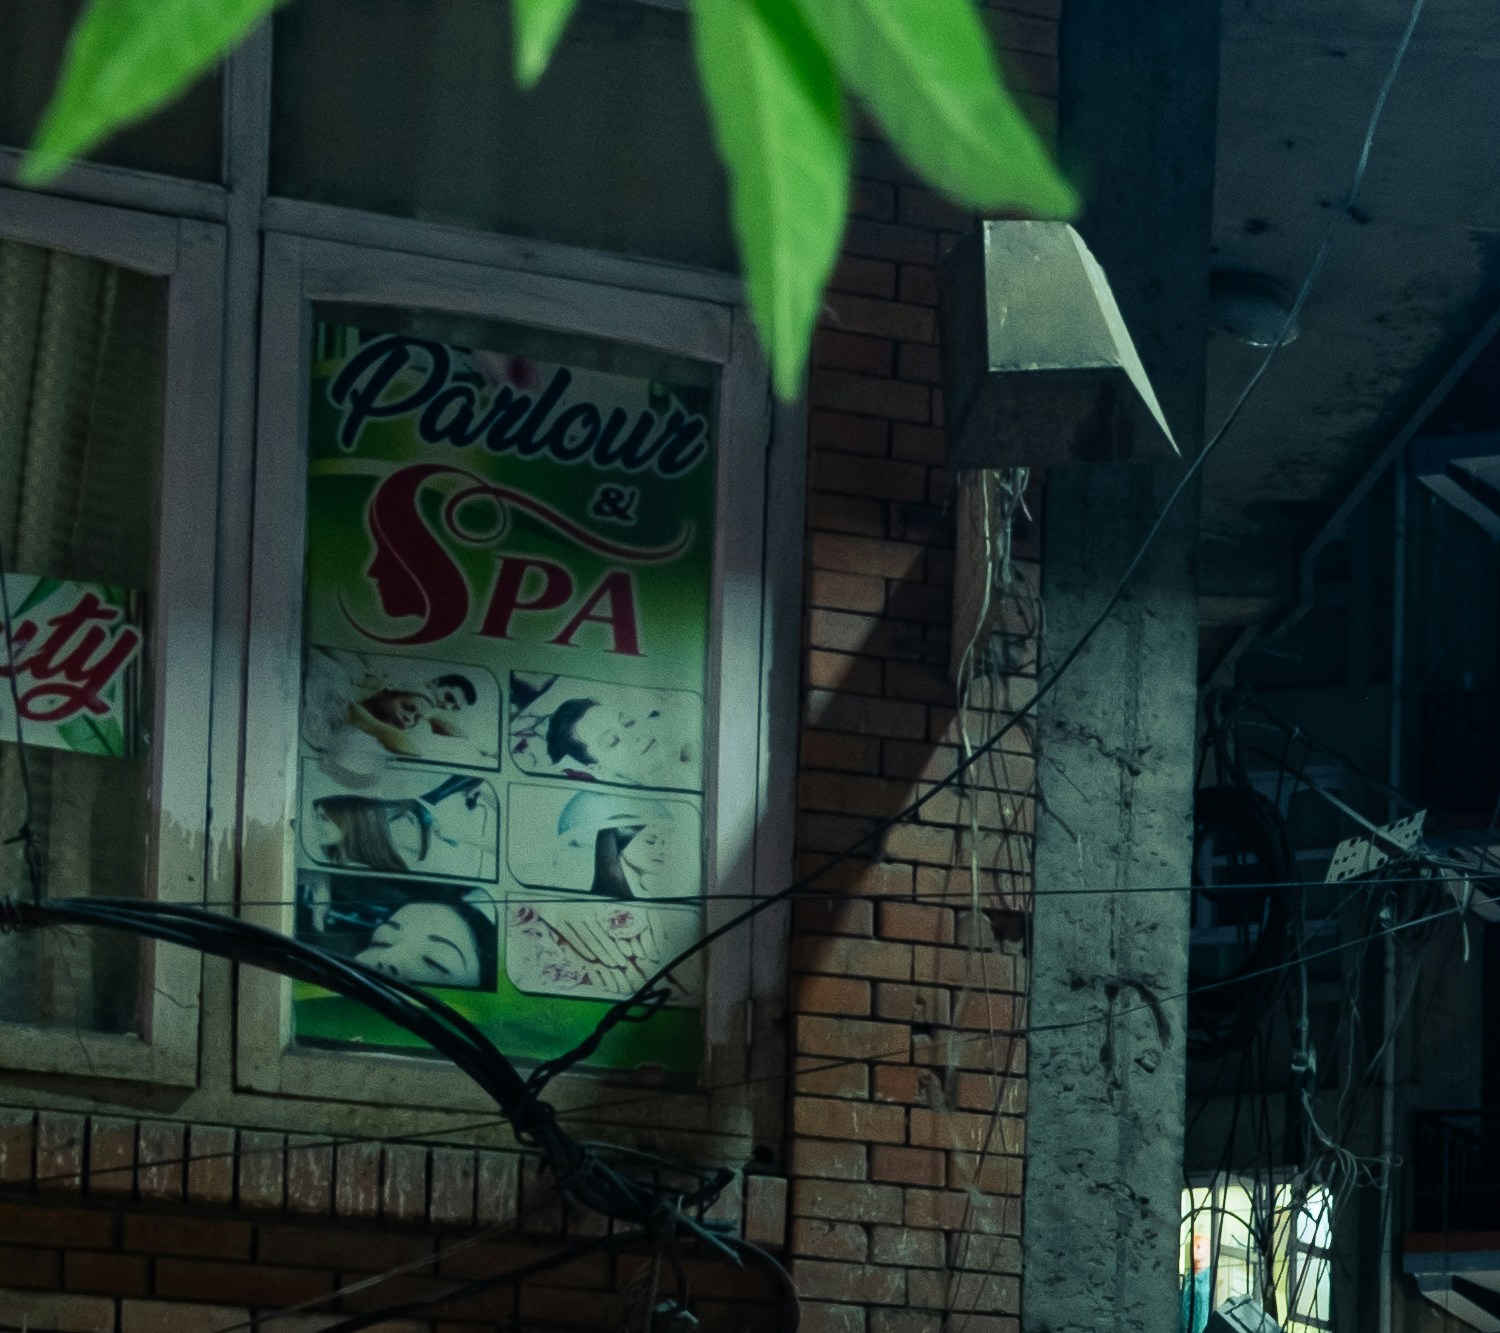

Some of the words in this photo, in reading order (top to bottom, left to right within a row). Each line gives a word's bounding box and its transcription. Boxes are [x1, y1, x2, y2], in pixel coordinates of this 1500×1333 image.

[331, 337, 709, 476] Parlour
[342, 463, 692, 658] SPA
[592, 484, 639, 526] &
